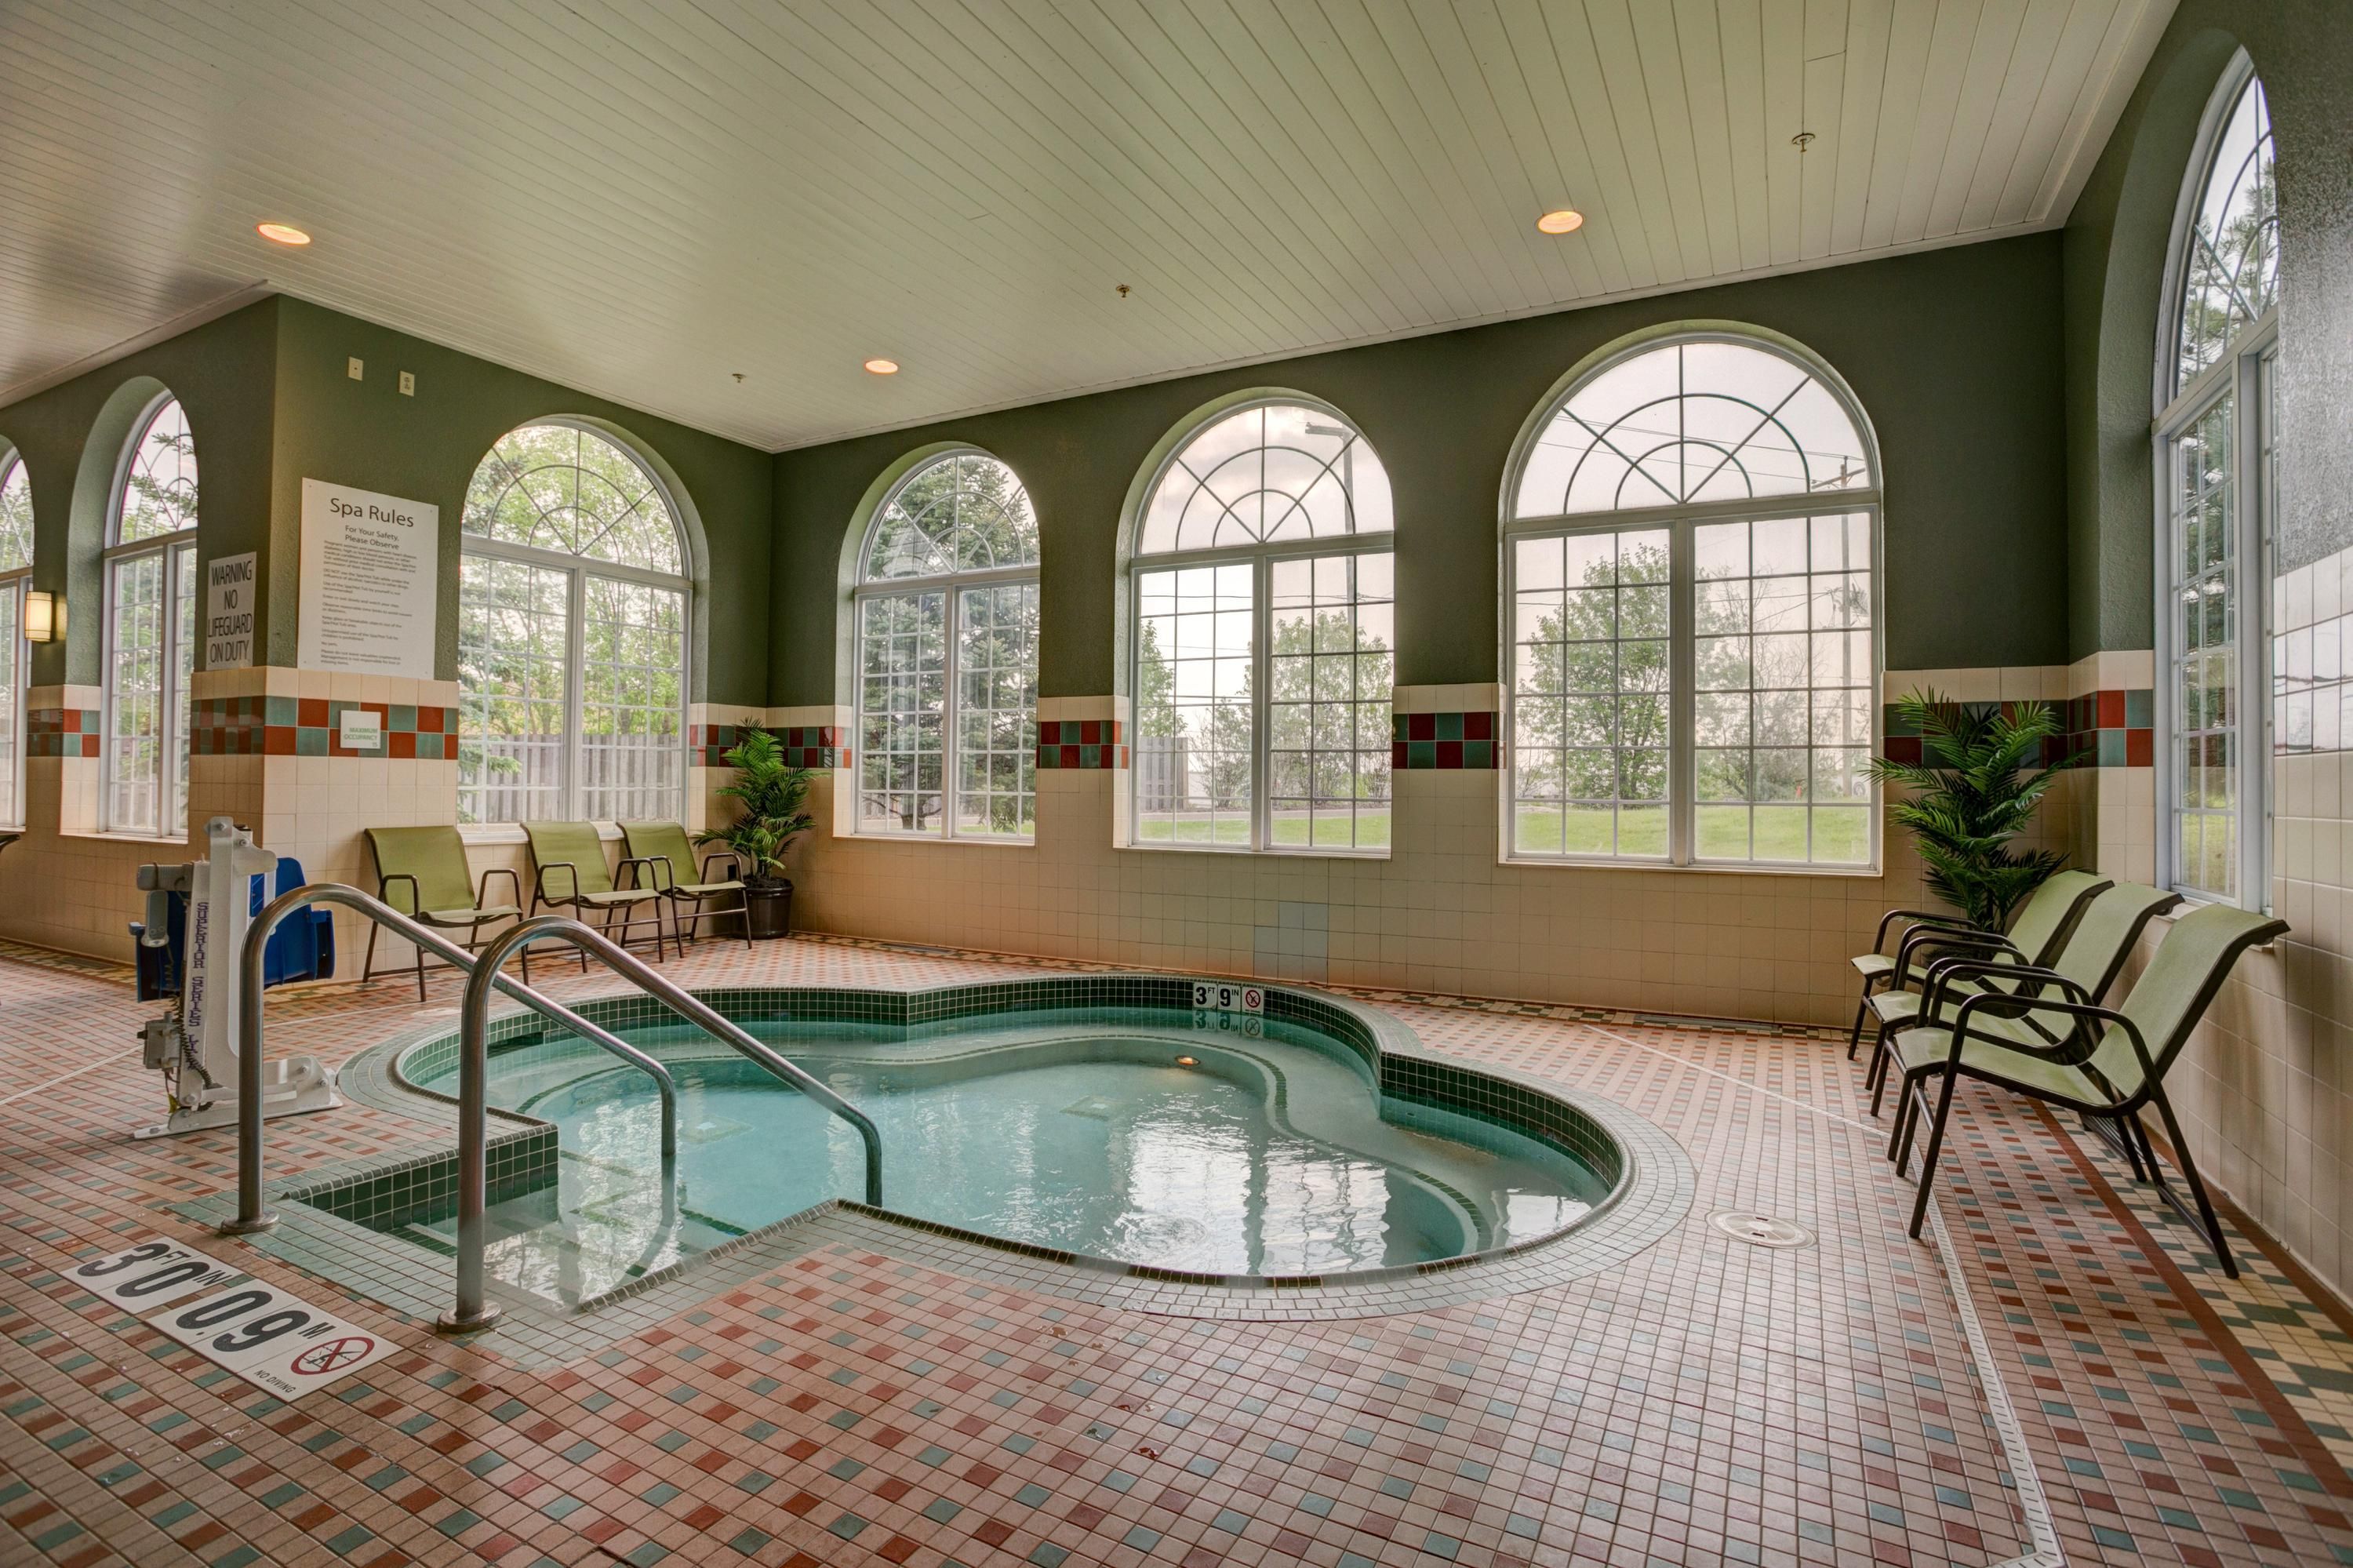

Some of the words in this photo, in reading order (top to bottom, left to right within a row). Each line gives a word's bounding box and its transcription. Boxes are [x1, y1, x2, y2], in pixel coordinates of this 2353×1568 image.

[329, 497, 363, 518] Spa
[369, 505, 414, 528] Rules
[345, 525, 357, 533] For
[358, 527, 375, 537] Your
[345, 534, 369, 544] Please
[369, 539, 400, 550] Observe
[211, 560, 253, 587] WARNING
[224, 589, 238, 610] NO
[207, 613, 253, 638] LIFEGUARD
[209, 642, 224, 663] ON
[225, 639, 249, 662] DUTY
[193, 902, 209, 969] SUPERIOR
[188, 977, 205, 1027] SERIES
[1195, 986, 1207, 1005] 3
[1220, 988, 1231, 1007] 9
[77, 1242, 171, 1277] 3
[115, 1261, 210, 1297] 0
[192, 1269, 231, 1286] IN
[175, 1290, 311, 1352] 0.9
[253, 1370, 271, 1379] NO
[266, 1377, 296, 1393] DIVING
